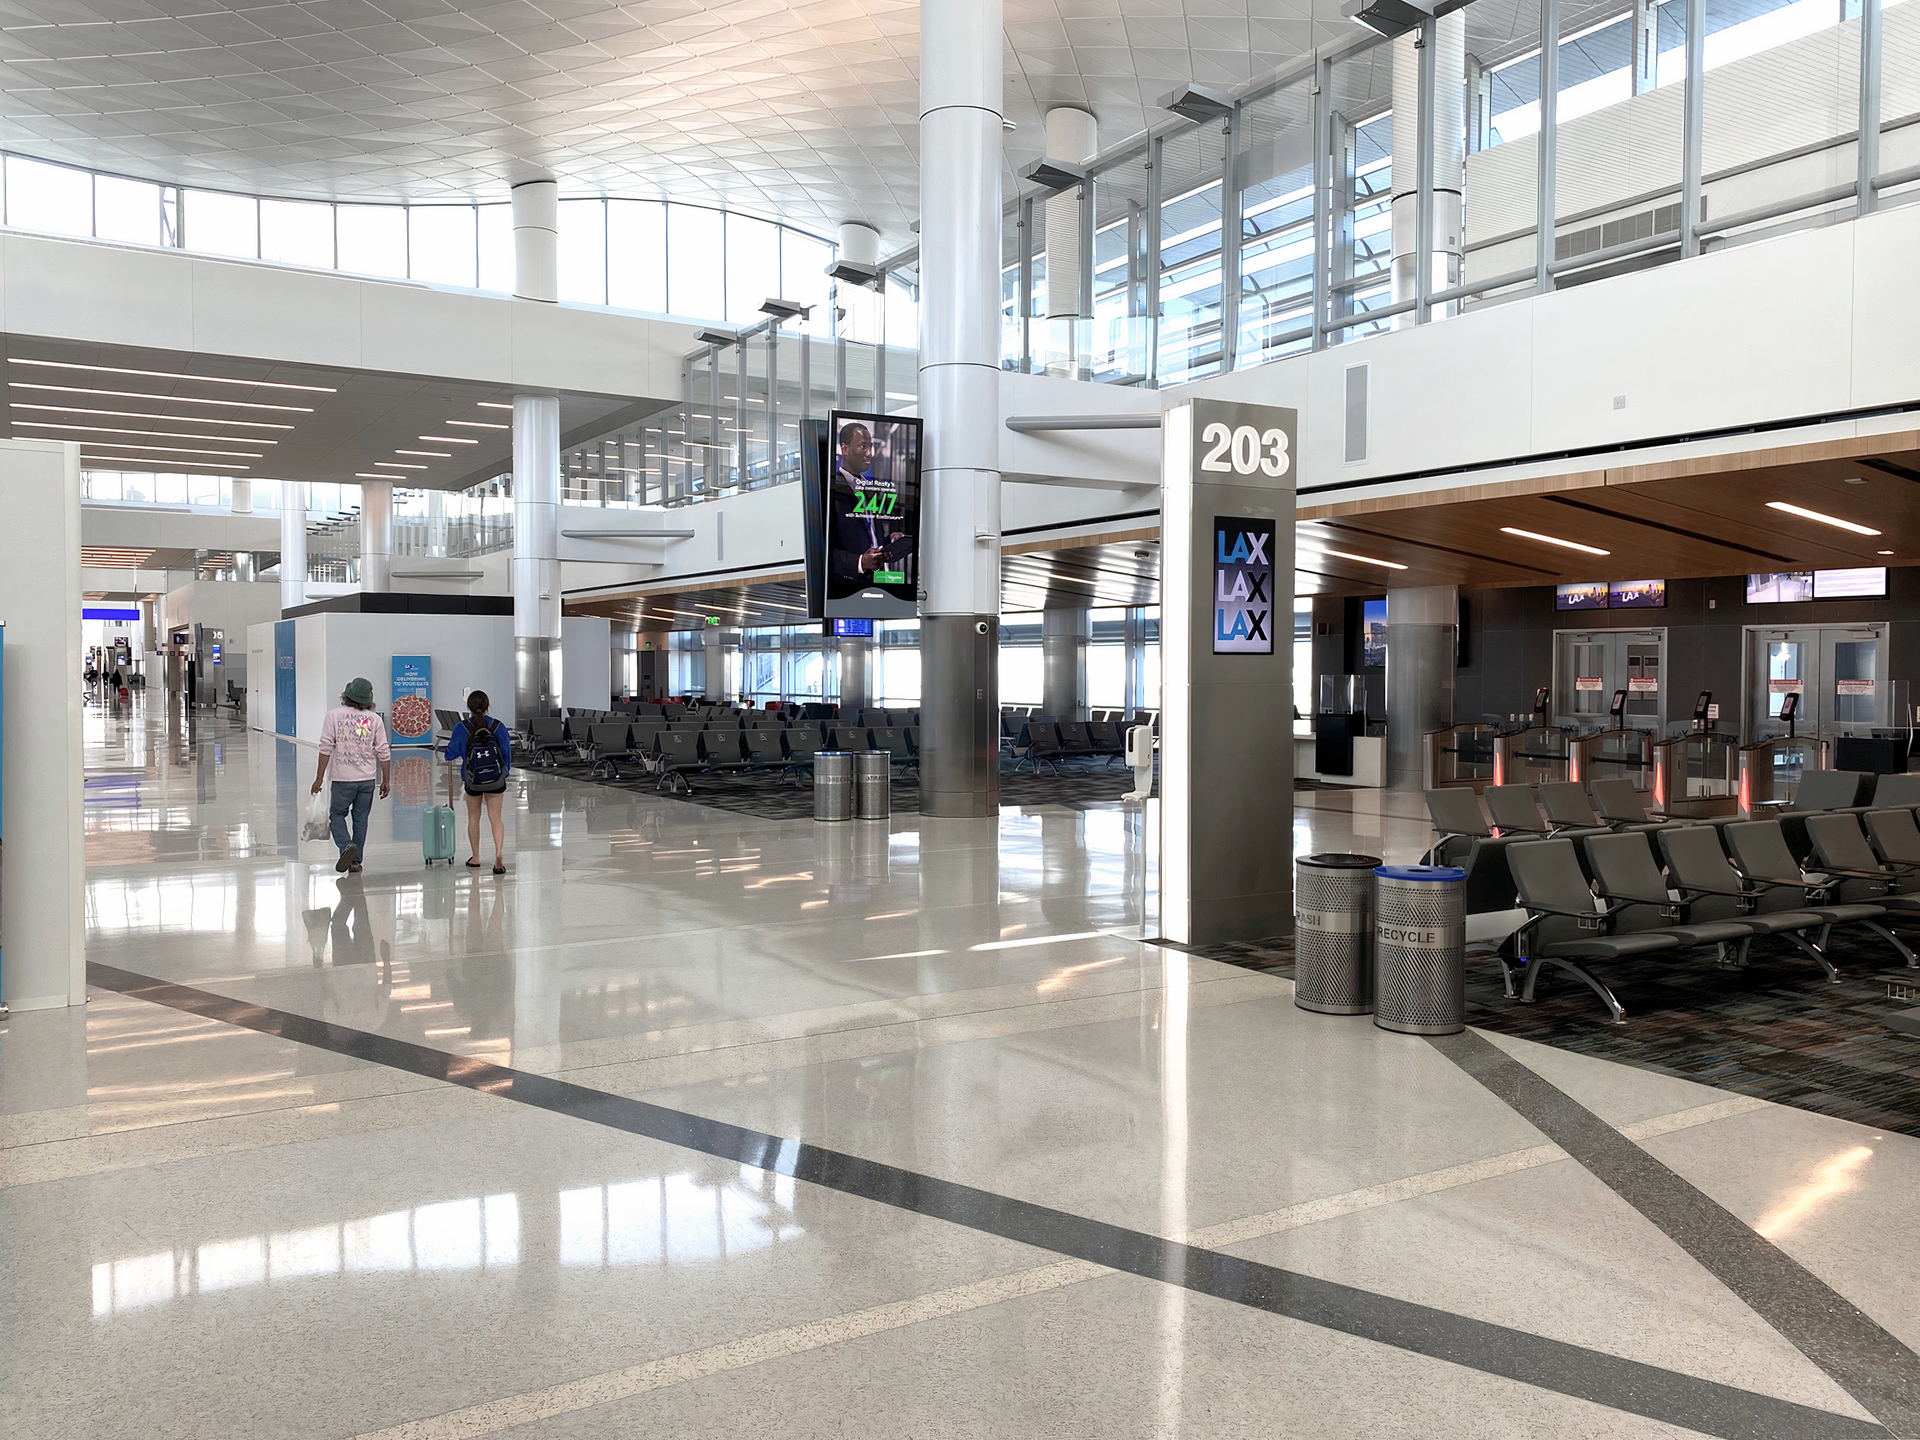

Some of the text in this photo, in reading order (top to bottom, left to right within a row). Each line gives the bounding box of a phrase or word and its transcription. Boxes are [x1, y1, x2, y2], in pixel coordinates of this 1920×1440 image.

[1200, 422, 1290, 477] 203
[855, 479, 874, 487] Digital
[853, 491, 898, 515] 24/7
[1218, 530, 1270, 566] LAX
[1218, 569, 1268, 604] LAX
[1622, 591, 1640, 602] LAX
[1568, 594, 1585, 605] LAX
[1218, 609, 1268, 641] LAX
[1378, 926, 1435, 943] RECYCLE
